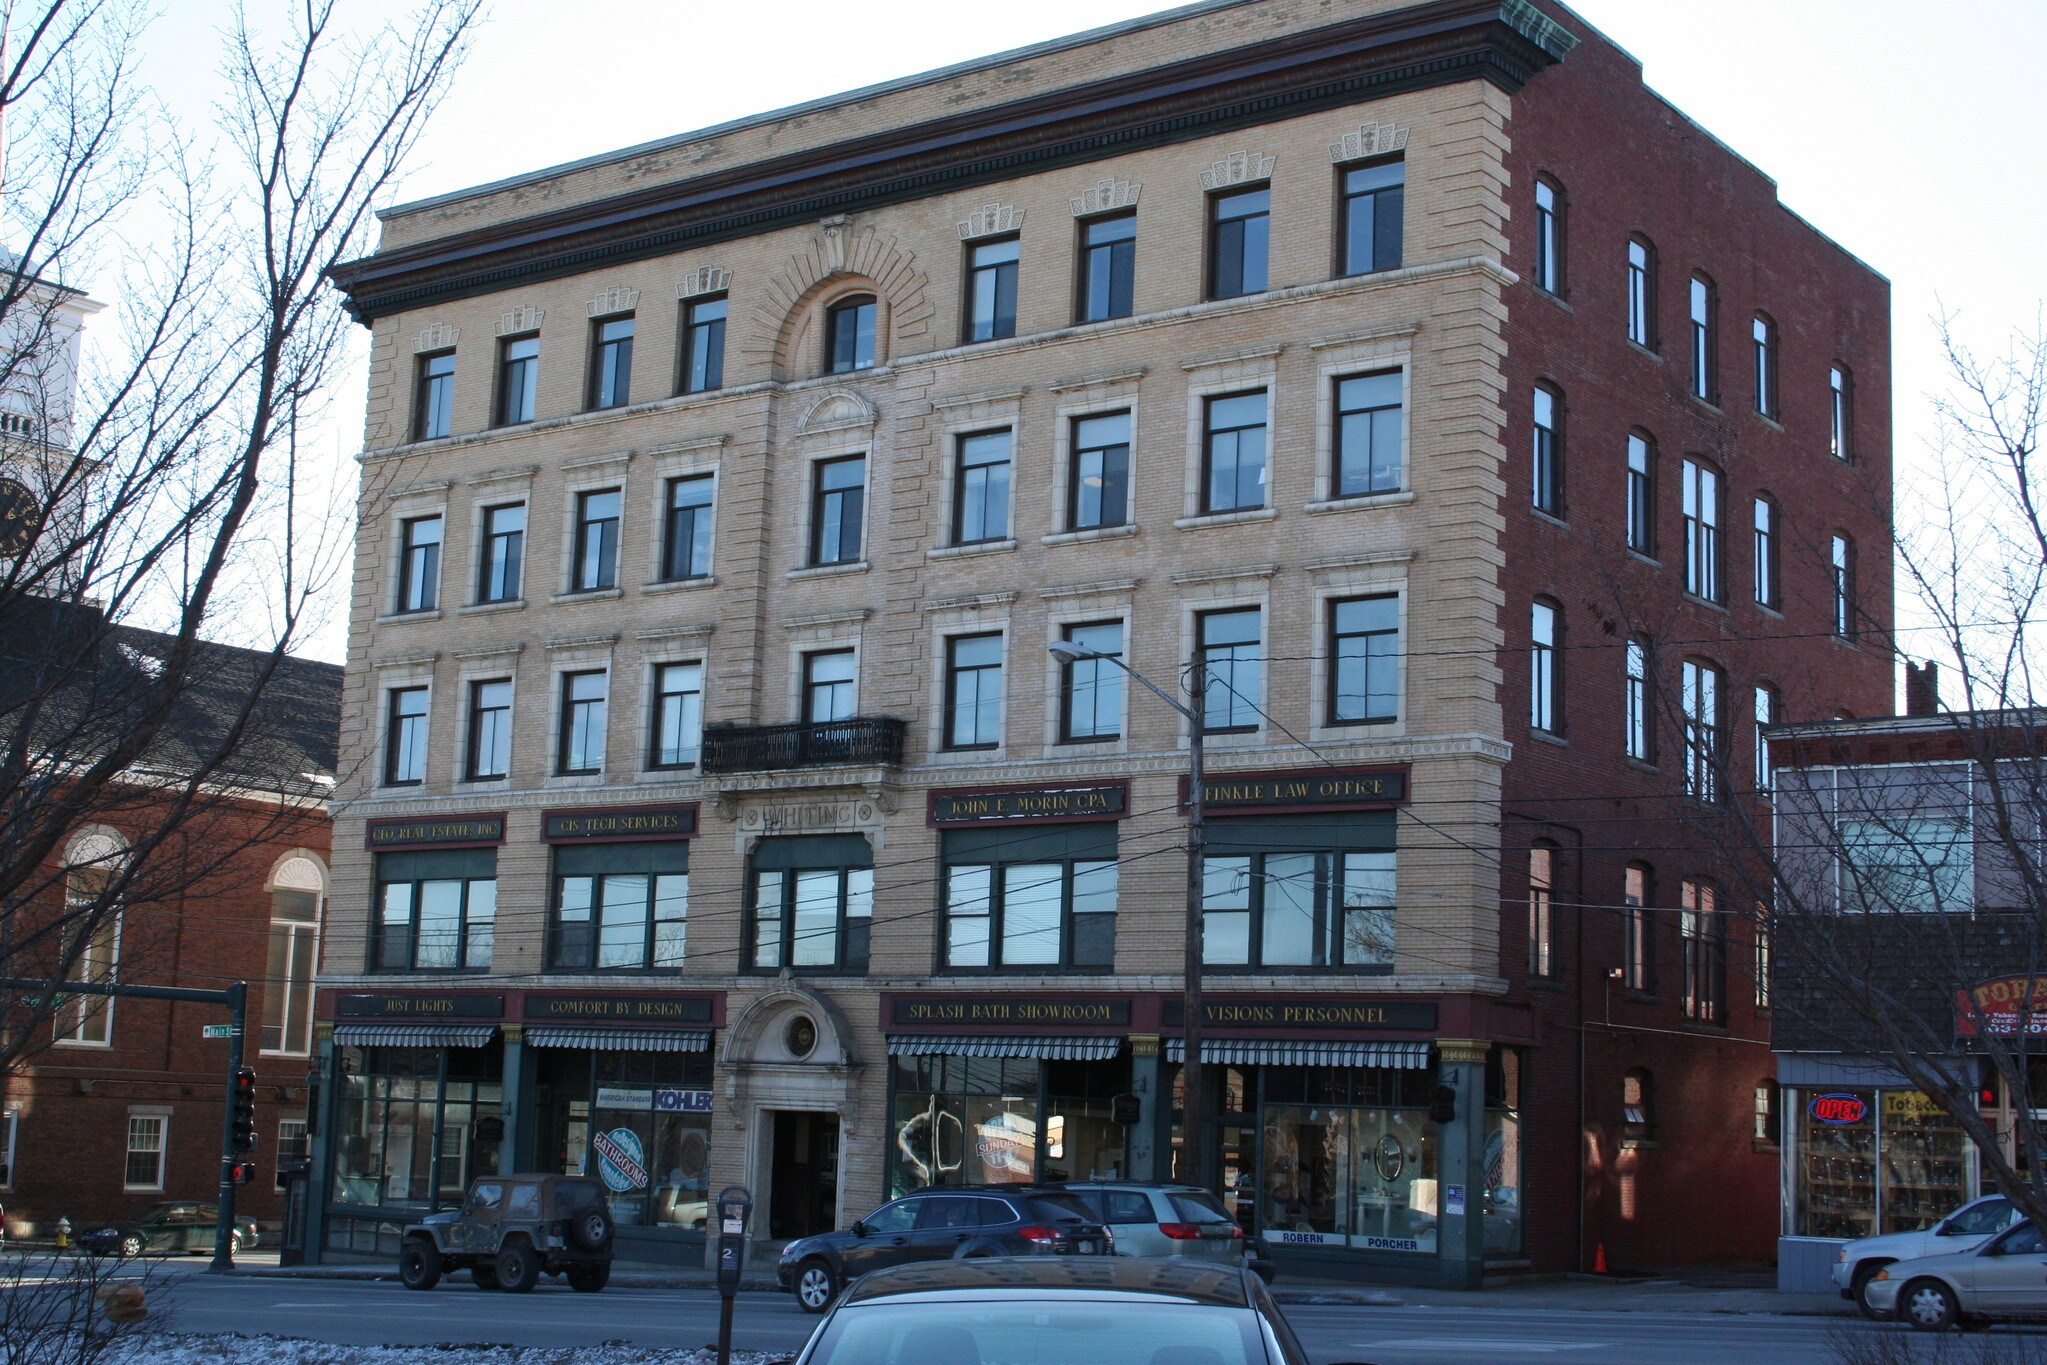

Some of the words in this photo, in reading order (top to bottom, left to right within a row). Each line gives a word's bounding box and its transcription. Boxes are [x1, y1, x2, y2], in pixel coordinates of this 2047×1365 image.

[1205, 784, 1264, 801] FINKLE
[1275, 782, 1310, 798] LAW
[1319, 779, 1385, 797] OFFICE
[951, 801, 988, 815] JOHN
[997, 799, 1009, 812] E.
[1017, 796, 1068, 811] MORIN
[1077, 794, 1108, 808] CPA
[561, 819, 579, 832] CIS
[585, 818, 616, 831] TECH
[621, 815, 678, 829] SERVICES
[373, 828, 394, 840] CFO
[400, 827, 425, 839] REAL
[385, 1000, 410, 1012] JUST
[415, 1000, 454, 1012] LIGHTS
[551, 1001, 610, 1014] COMFORT
[616, 1002, 631, 1015] BY
[638, 1002, 683, 1016] DESIGN
[910, 1004, 964, 1019] SPLASH
[972, 1004, 1010, 1018] BATH
[1018, 1004, 1111, 1020] SHOWROOM
[1206, 1006, 1274, 1021] VISIONS
[1284, 1006, 1388, 1023] PERSONNEL
[210, 1027, 225, 1036] Main
[656, 1090, 713, 1110] KOHLER
[1816, 1098, 1864, 1121] OPEN
[593, 1132, 649, 1188] BATHROOMS
[1282, 1232, 1324, 1244] ROBERN
[1368, 1238, 1418, 1250] PORCHER
[722, 1248, 732, 1259] 2
